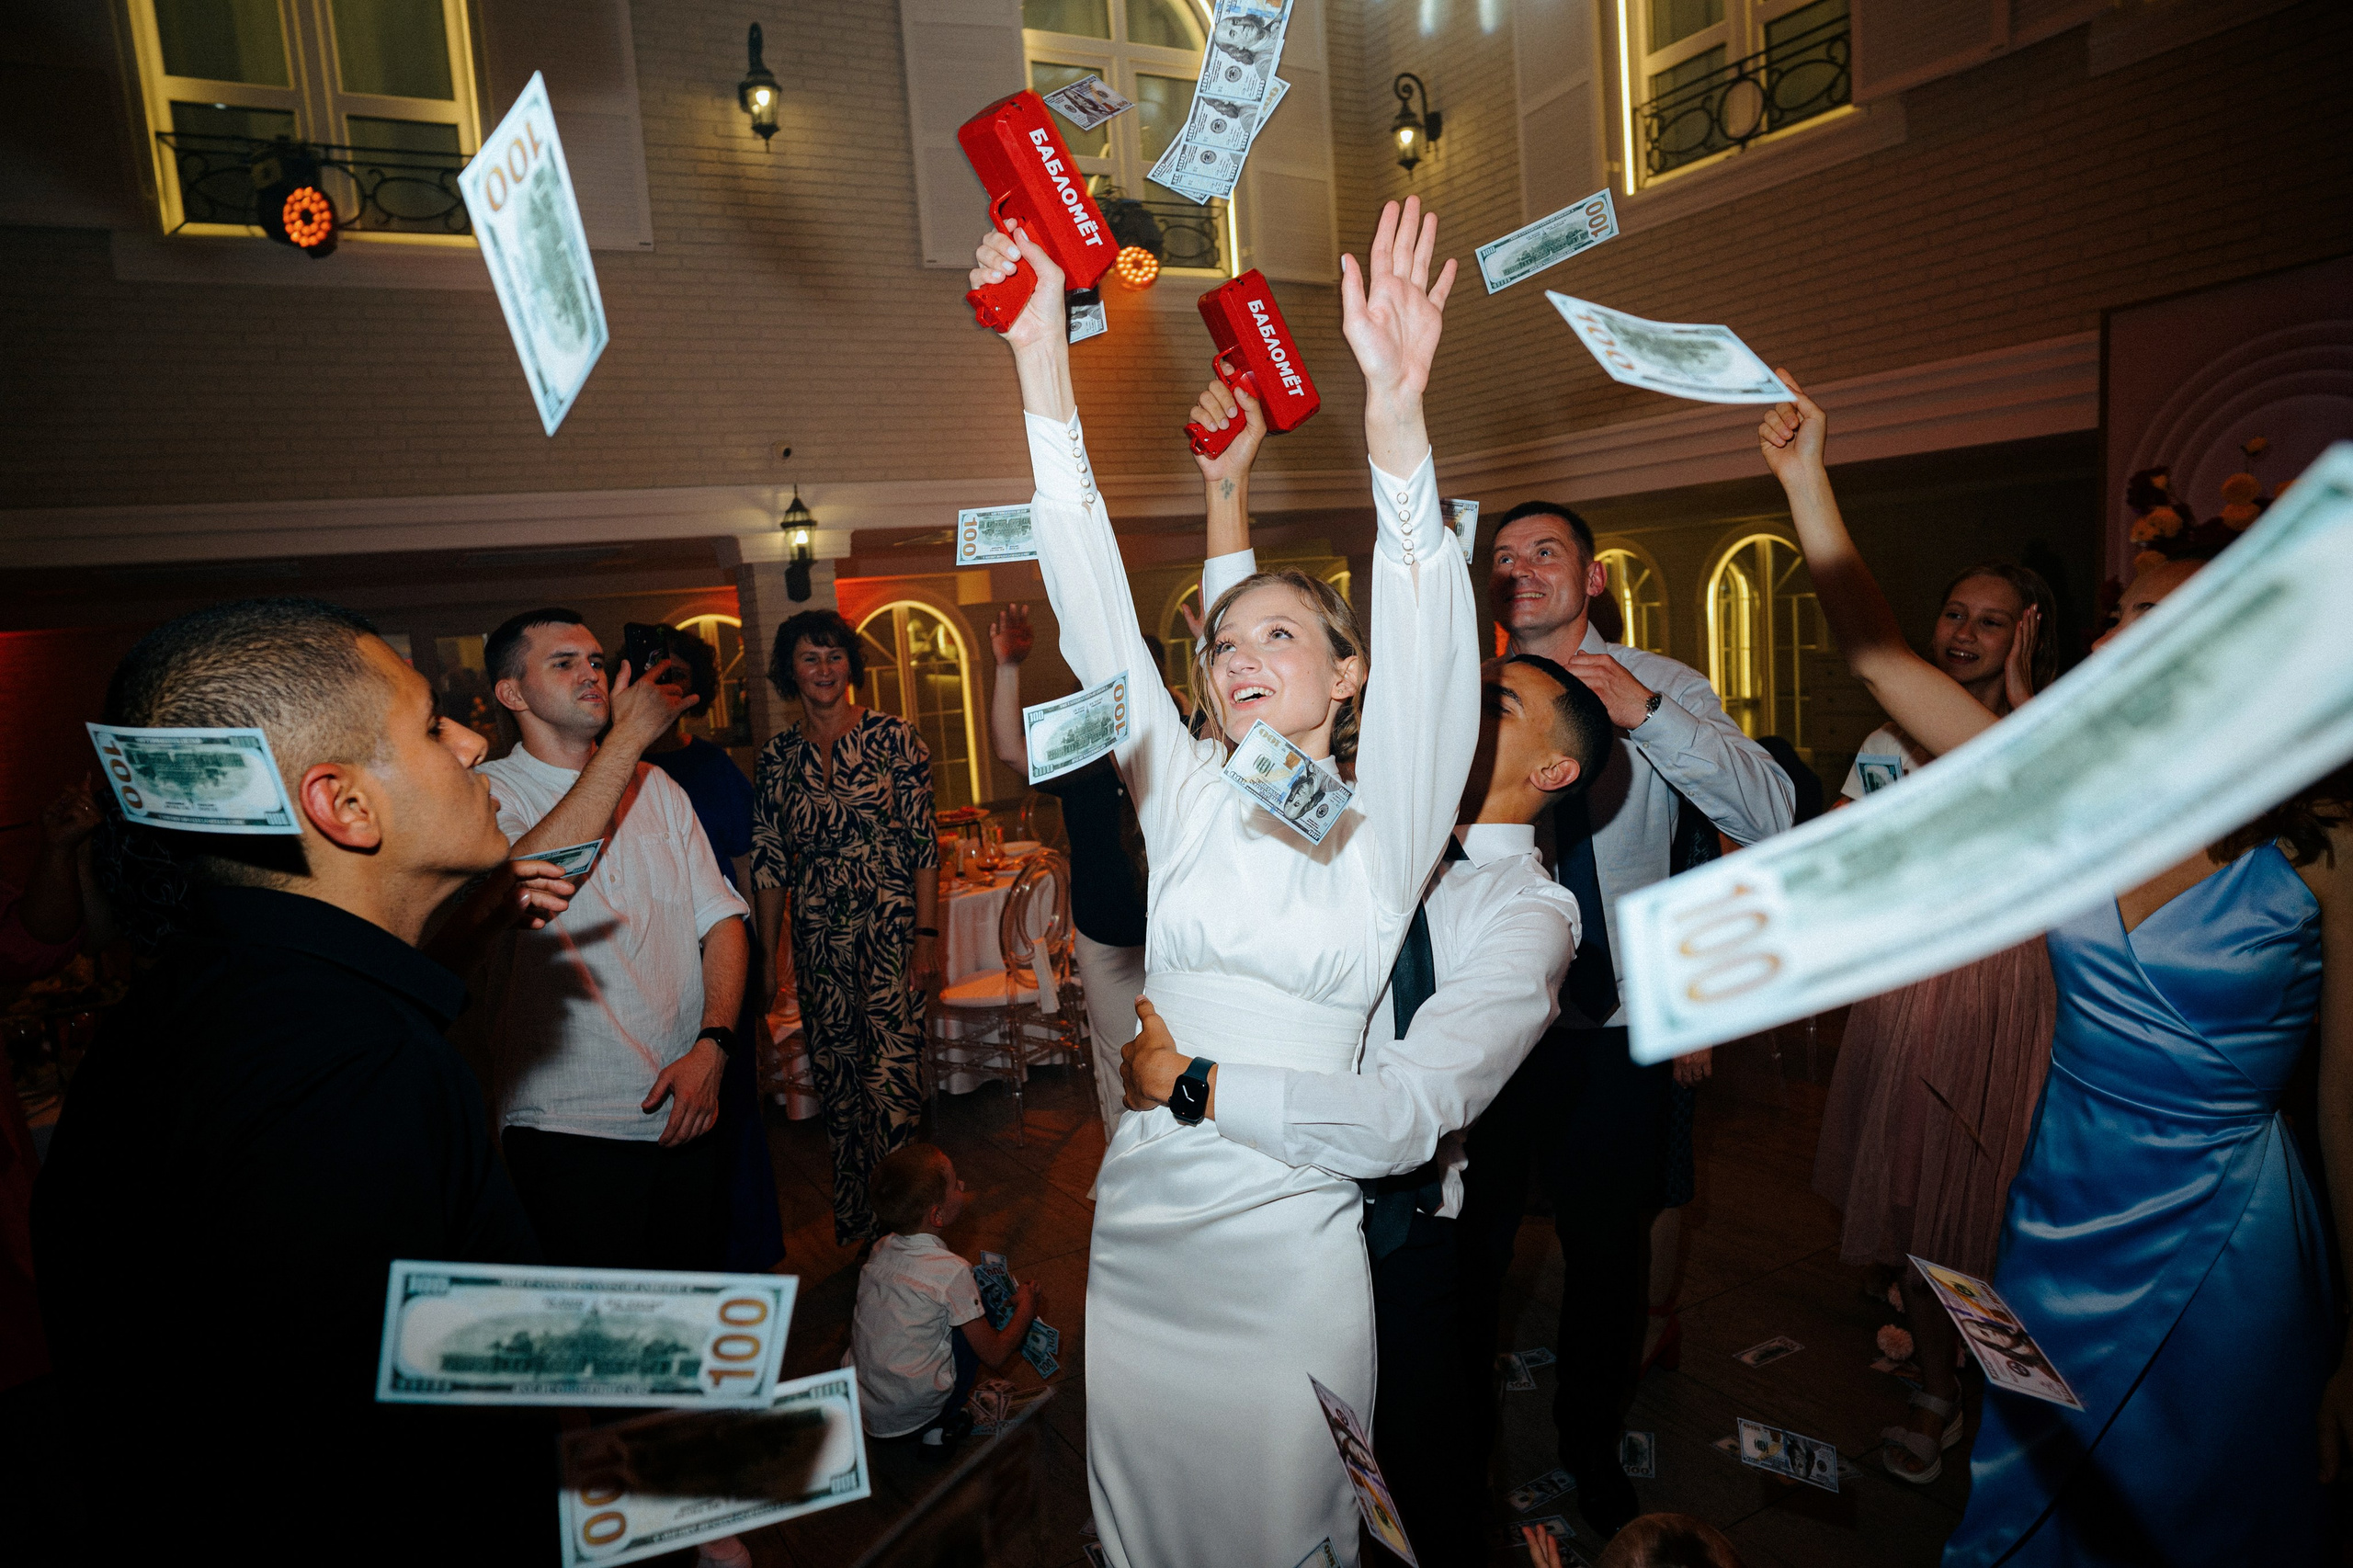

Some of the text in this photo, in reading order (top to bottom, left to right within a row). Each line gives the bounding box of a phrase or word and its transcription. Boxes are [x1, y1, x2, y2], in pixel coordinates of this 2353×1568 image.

[1200, 71, 1211, 93] 100
[1256, 79, 1267, 102] 100
[1186, 122, 1196, 142] 100
[1240, 131, 1251, 153] 100
[485, 120, 542, 212] 100
[1176, 153, 1187, 172] 100
[1029, 128, 1103, 246] БАБЛОМЁТ
[1586, 200, 1609, 238] 100
[1483, 246, 1496, 256] 100
[1247, 300, 1304, 396] БАБЛОМЁТ
[1576, 314, 1634, 369] 100
[963, 517, 978, 557] 100
[1029, 710, 1045, 722] 100
[1114, 684, 1126, 735] 100
[1258, 728, 1281, 747] 100
[103, 741, 143, 809] 100
[1307, 830, 1321, 841] 100
[1672, 882, 1781, 1003] 100
[708, 1299, 767, 1388] 100
